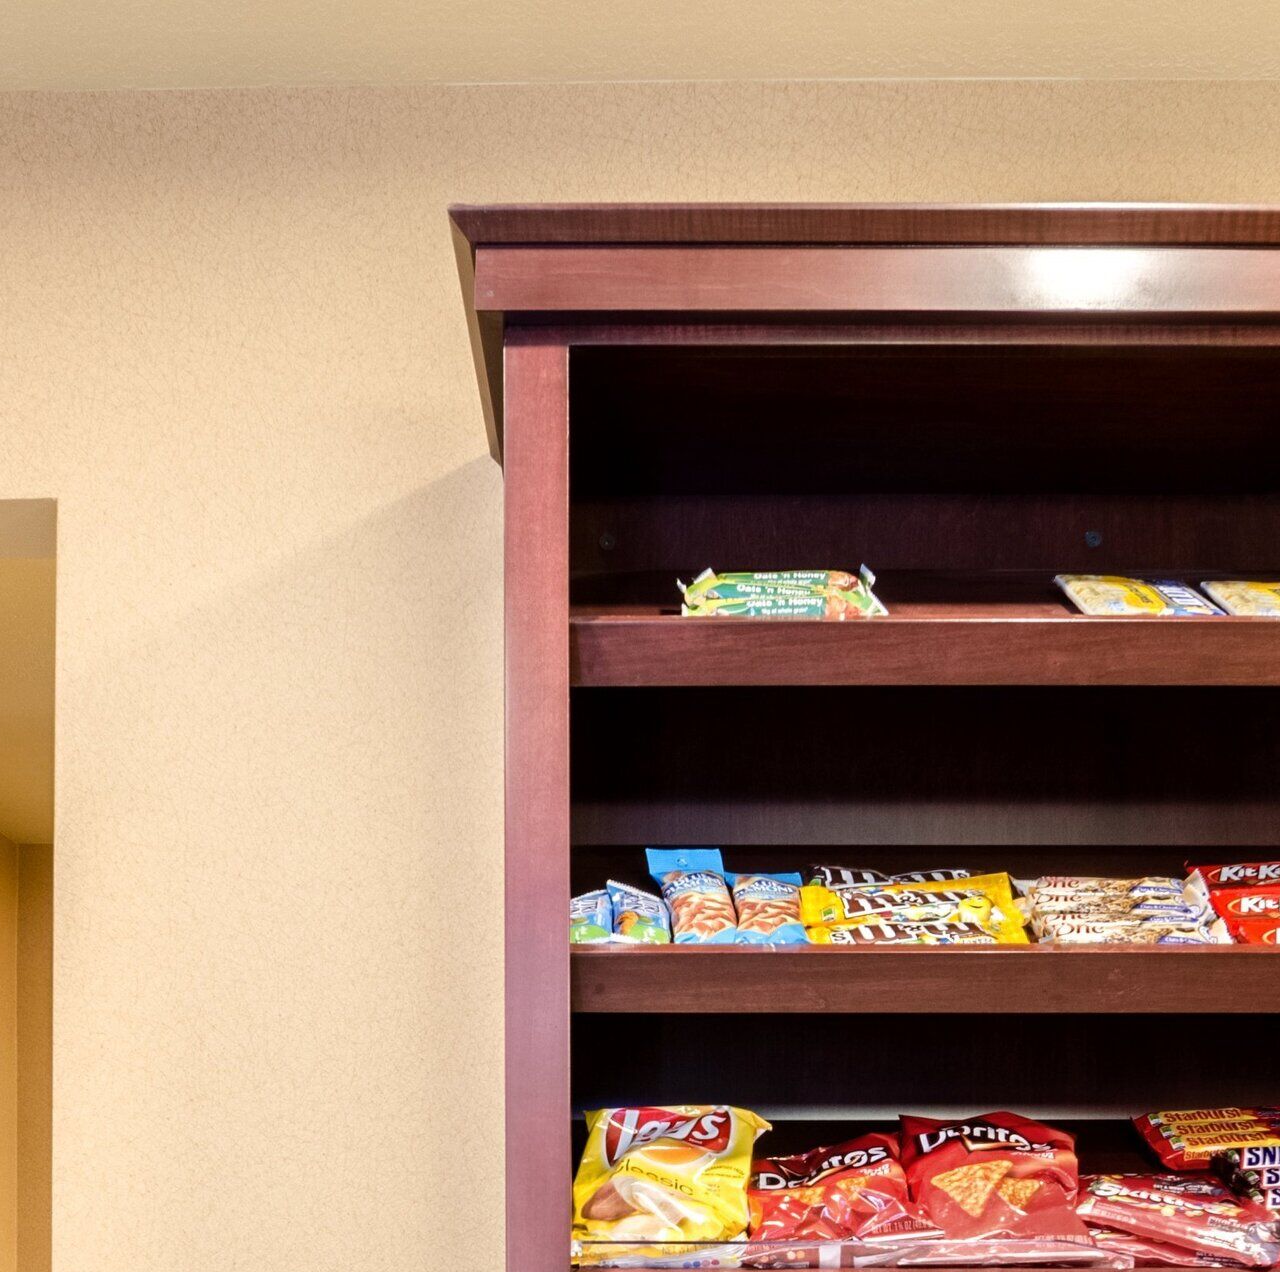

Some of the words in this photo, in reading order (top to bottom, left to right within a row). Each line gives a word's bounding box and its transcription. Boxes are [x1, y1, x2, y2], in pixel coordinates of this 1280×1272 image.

[1164, 1109, 1242, 1122] Starburst
[1176, 1120, 1257, 1135] Starburst
[1186, 1131, 1269, 1147] Starburst
[759, 1147, 888, 1190] Doitos
[615, 1158, 695, 1197] Classic
